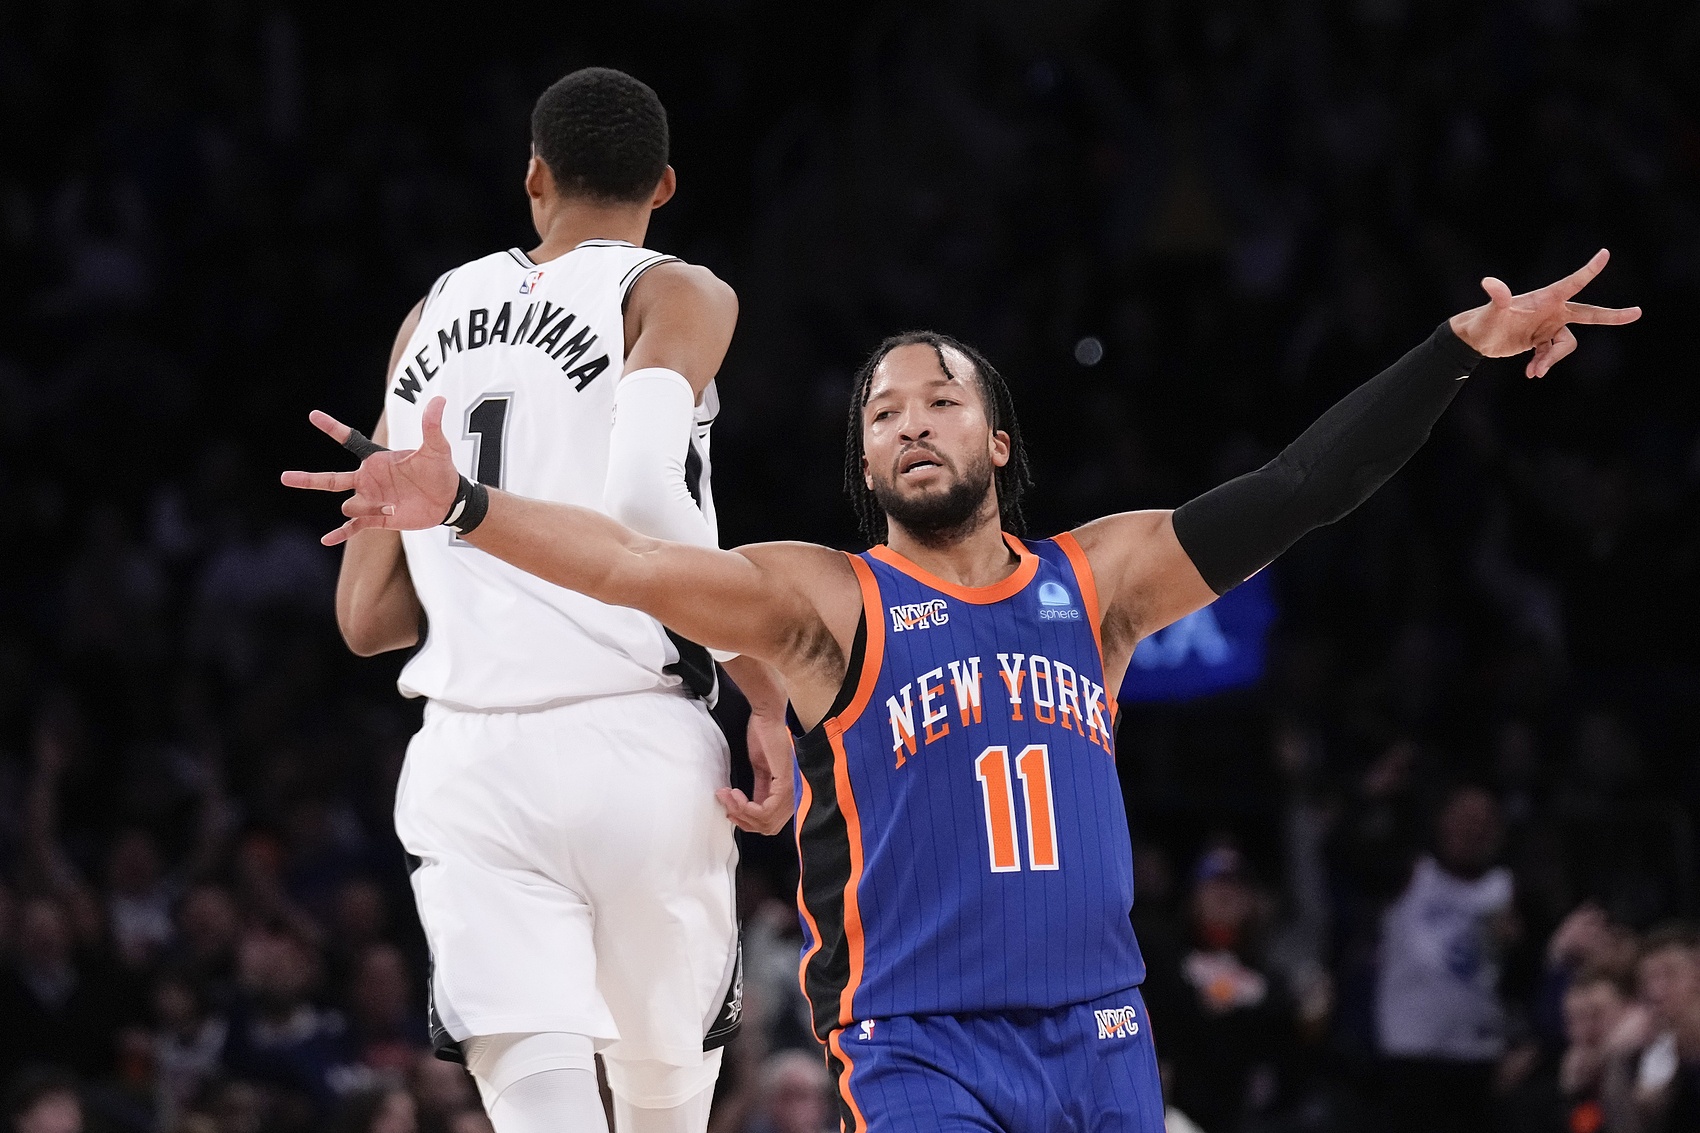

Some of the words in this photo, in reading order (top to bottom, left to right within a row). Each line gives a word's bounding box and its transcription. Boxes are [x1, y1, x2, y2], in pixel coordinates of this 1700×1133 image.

[393, 300, 610, 405] WEMBANYAMA
[449, 391, 515, 547] 1
[890, 599, 949, 632] NYC
[1039, 608, 1079, 620] sphere
[886, 656, 981, 755] NEW
[997, 653, 1110, 742] YORK
[974, 744, 1060, 873] 11
[1094, 1006, 1139, 1039] NYC
